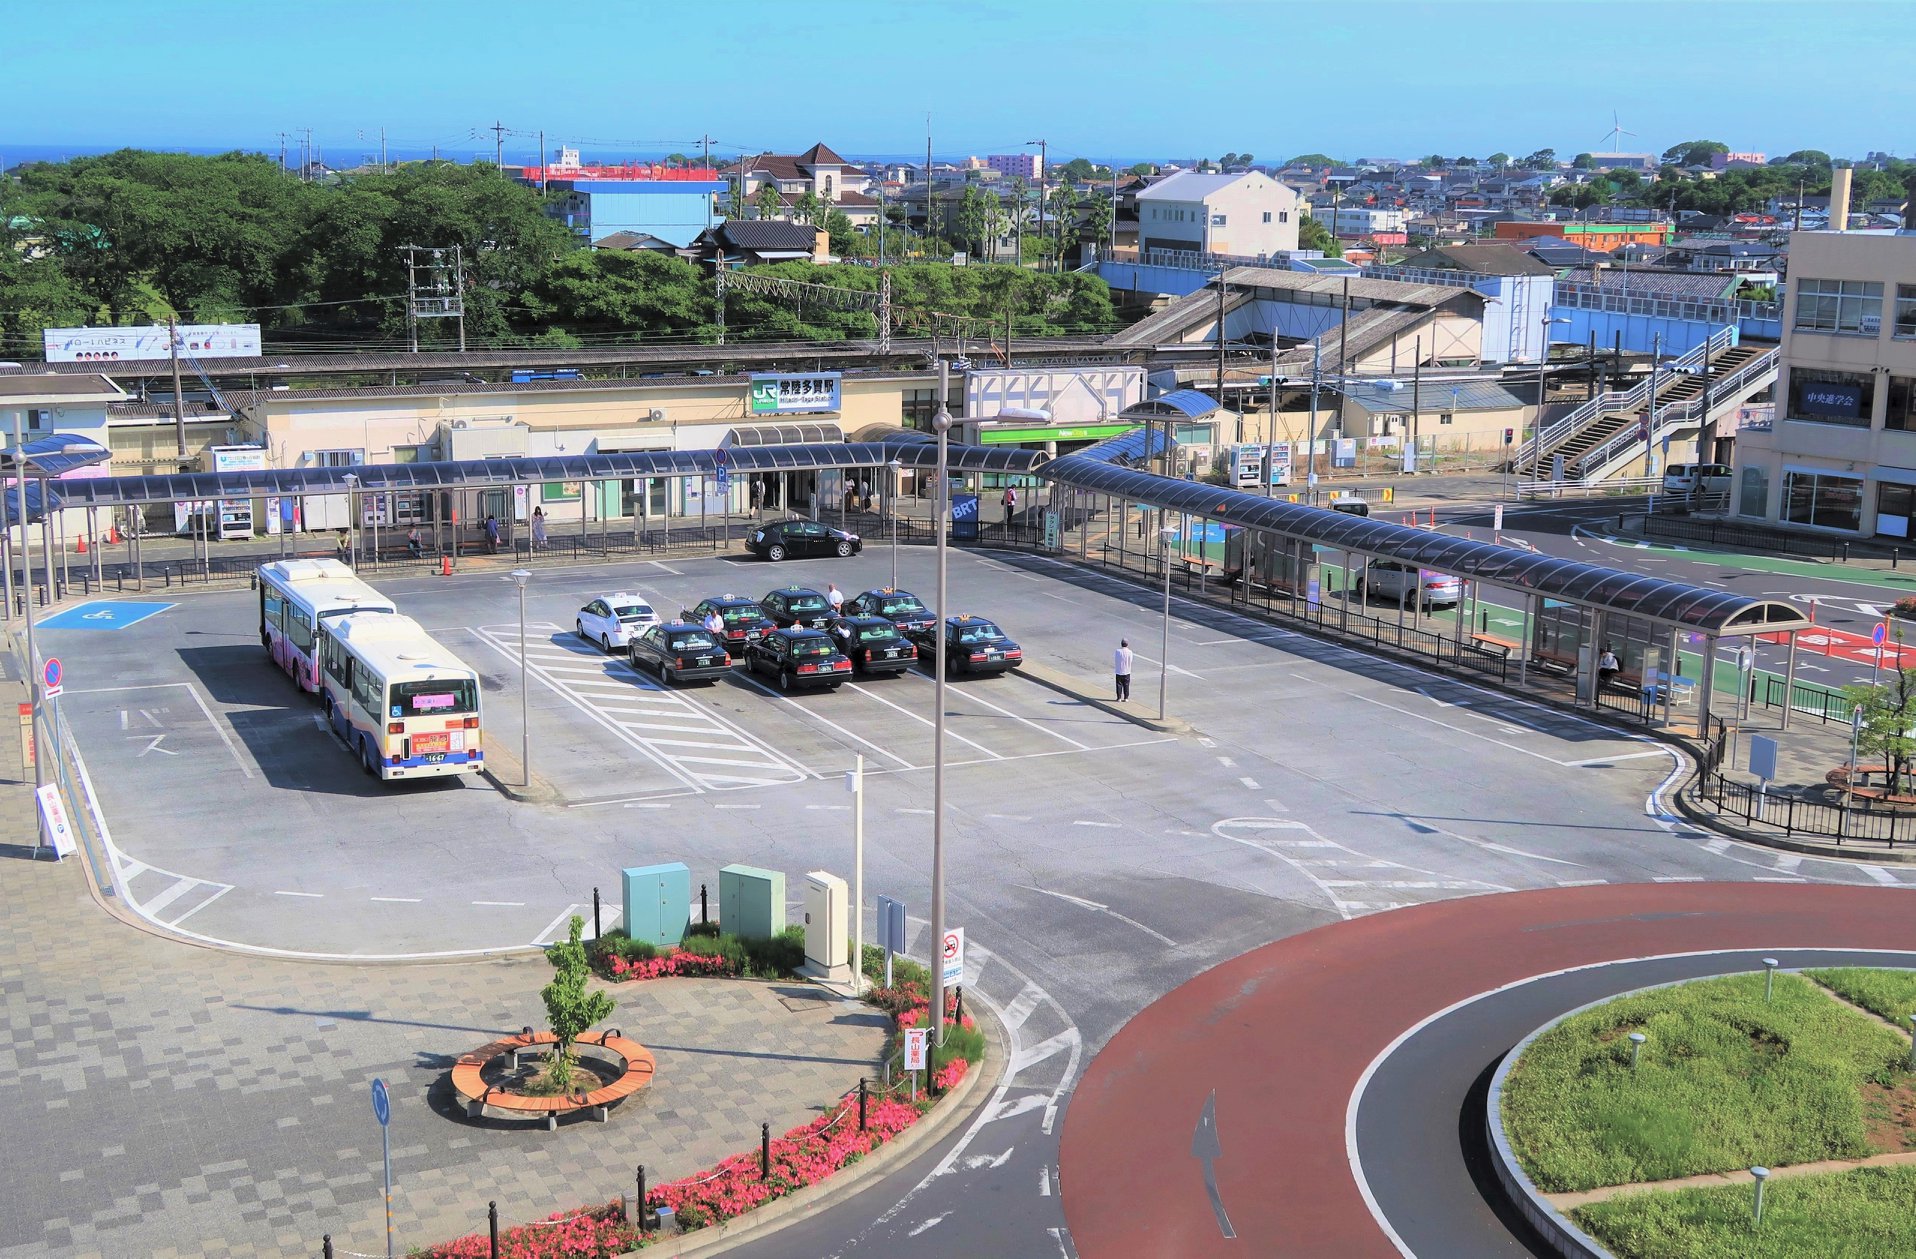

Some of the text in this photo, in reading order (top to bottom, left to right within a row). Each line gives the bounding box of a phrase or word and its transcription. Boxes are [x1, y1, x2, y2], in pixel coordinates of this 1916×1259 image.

[754, 384, 777, 399] JR
[780, 379, 834, 395] 常陸多賀駅
[1808, 392, 1854, 406] 中央進学会
[719, 468, 725, 480] P
[952, 498, 977, 519] BRT
[911, 1036, 920, 1063] 長山薬局
